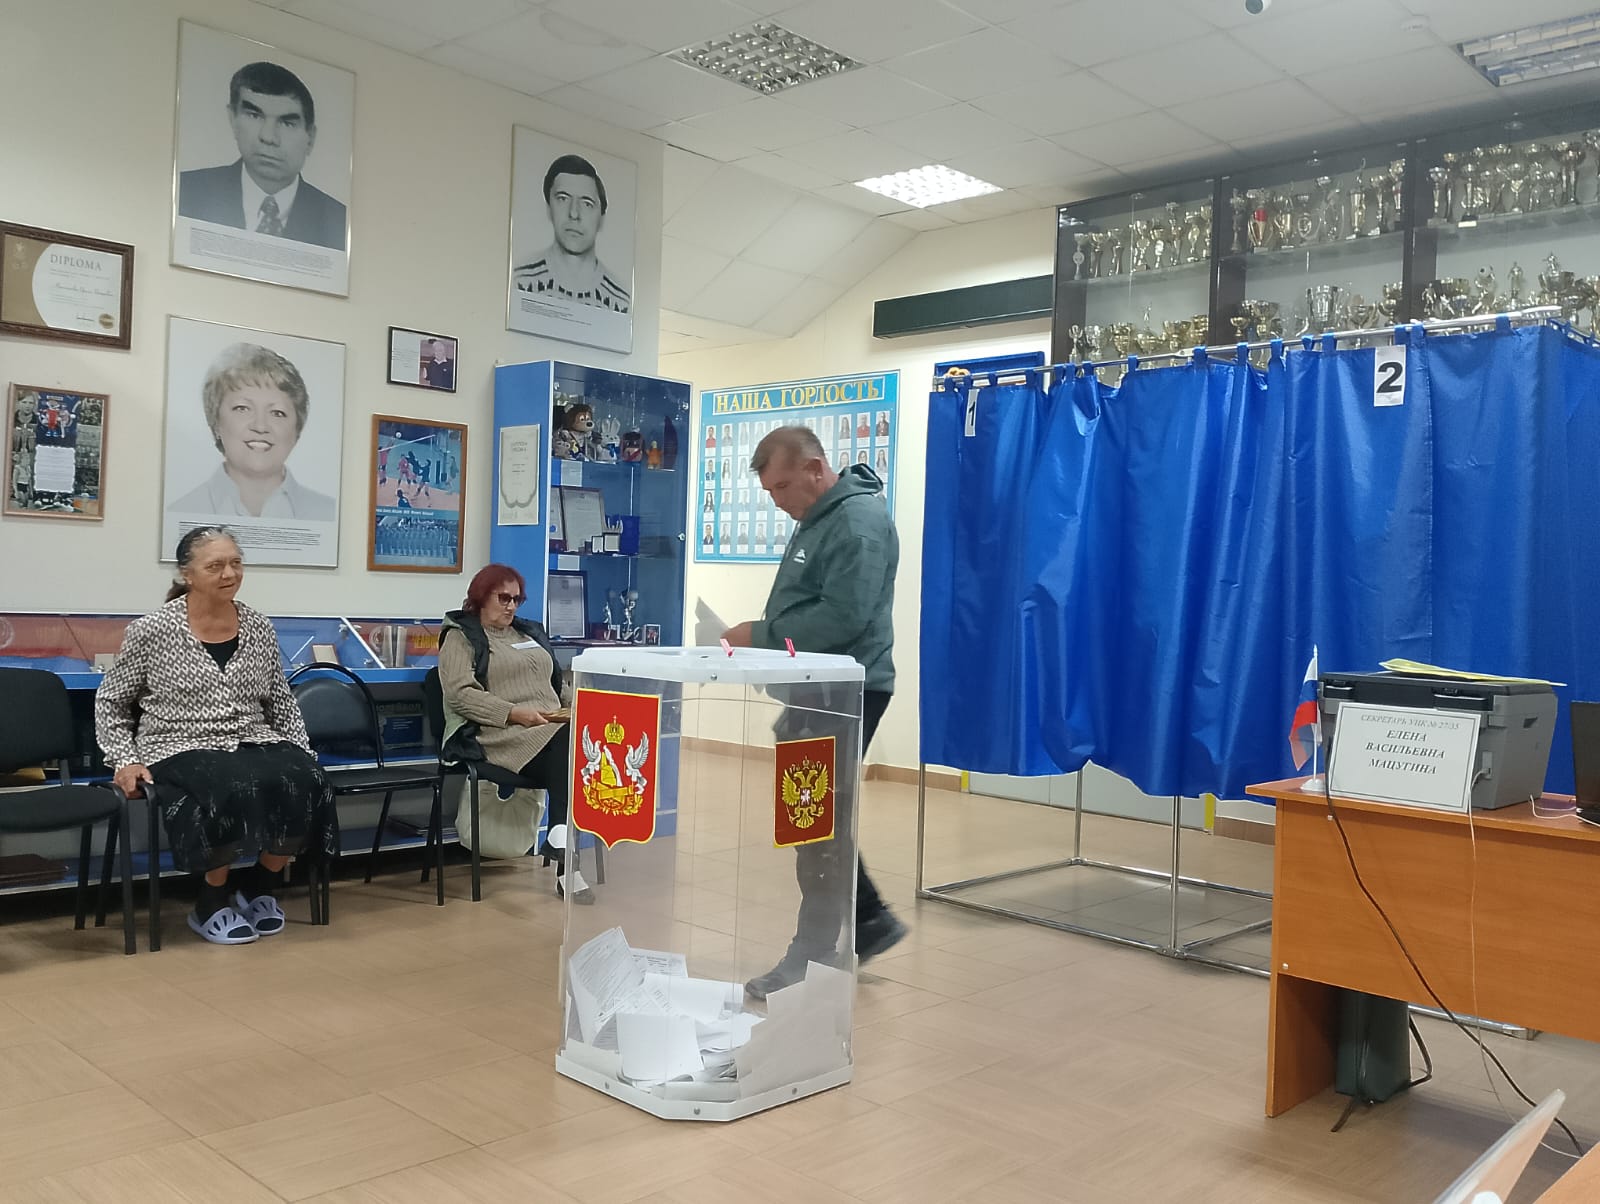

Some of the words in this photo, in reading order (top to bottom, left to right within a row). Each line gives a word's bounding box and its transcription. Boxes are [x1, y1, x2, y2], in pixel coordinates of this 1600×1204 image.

[50, 254, 102, 271] DIPLOMA
[1376, 361, 1404, 394] 2
[716, 391, 772, 413] НАША
[781, 379, 879, 408] ГОРДОСТЬ
[968, 400, 976, 427] 1
[1386, 729, 1428, 742] ЕЛЕНА
[1366, 741, 1446, 760] ВАСИЛЬЕВНА
